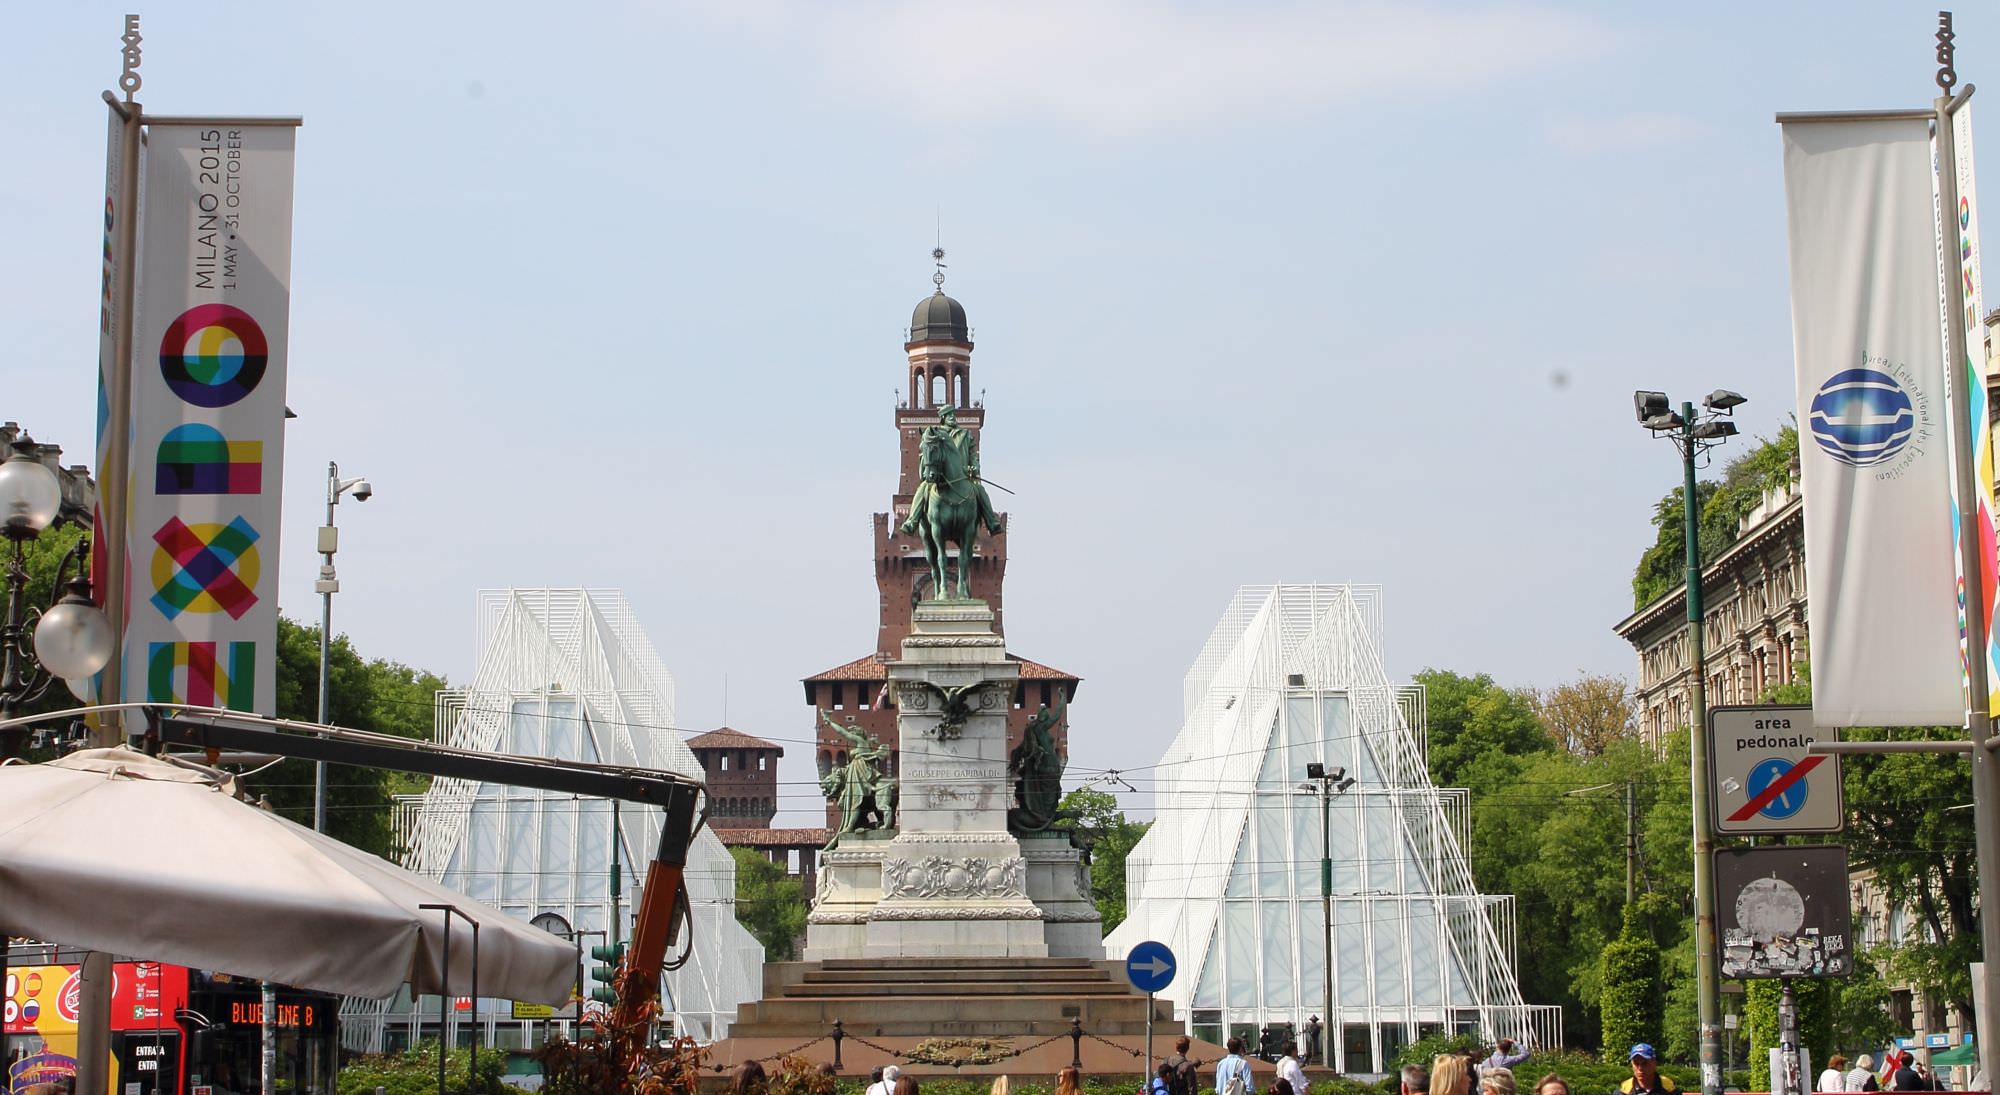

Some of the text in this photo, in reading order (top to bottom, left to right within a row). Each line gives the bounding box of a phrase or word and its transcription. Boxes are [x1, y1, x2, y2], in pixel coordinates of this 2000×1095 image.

[119, 14, 142, 92] EXPO
[226, 130, 242, 208] OCTOBER
[195, 130, 221, 289] MILANO 2015
[225, 213, 239, 229] 31
[224, 246, 238, 278] MAY
[1862, 351, 1892, 368] Bureau
[1893, 363, 1936, 427] International
[1754, 719, 1791, 730] area
[232, 1002, 313, 1026] BLUE INE B
